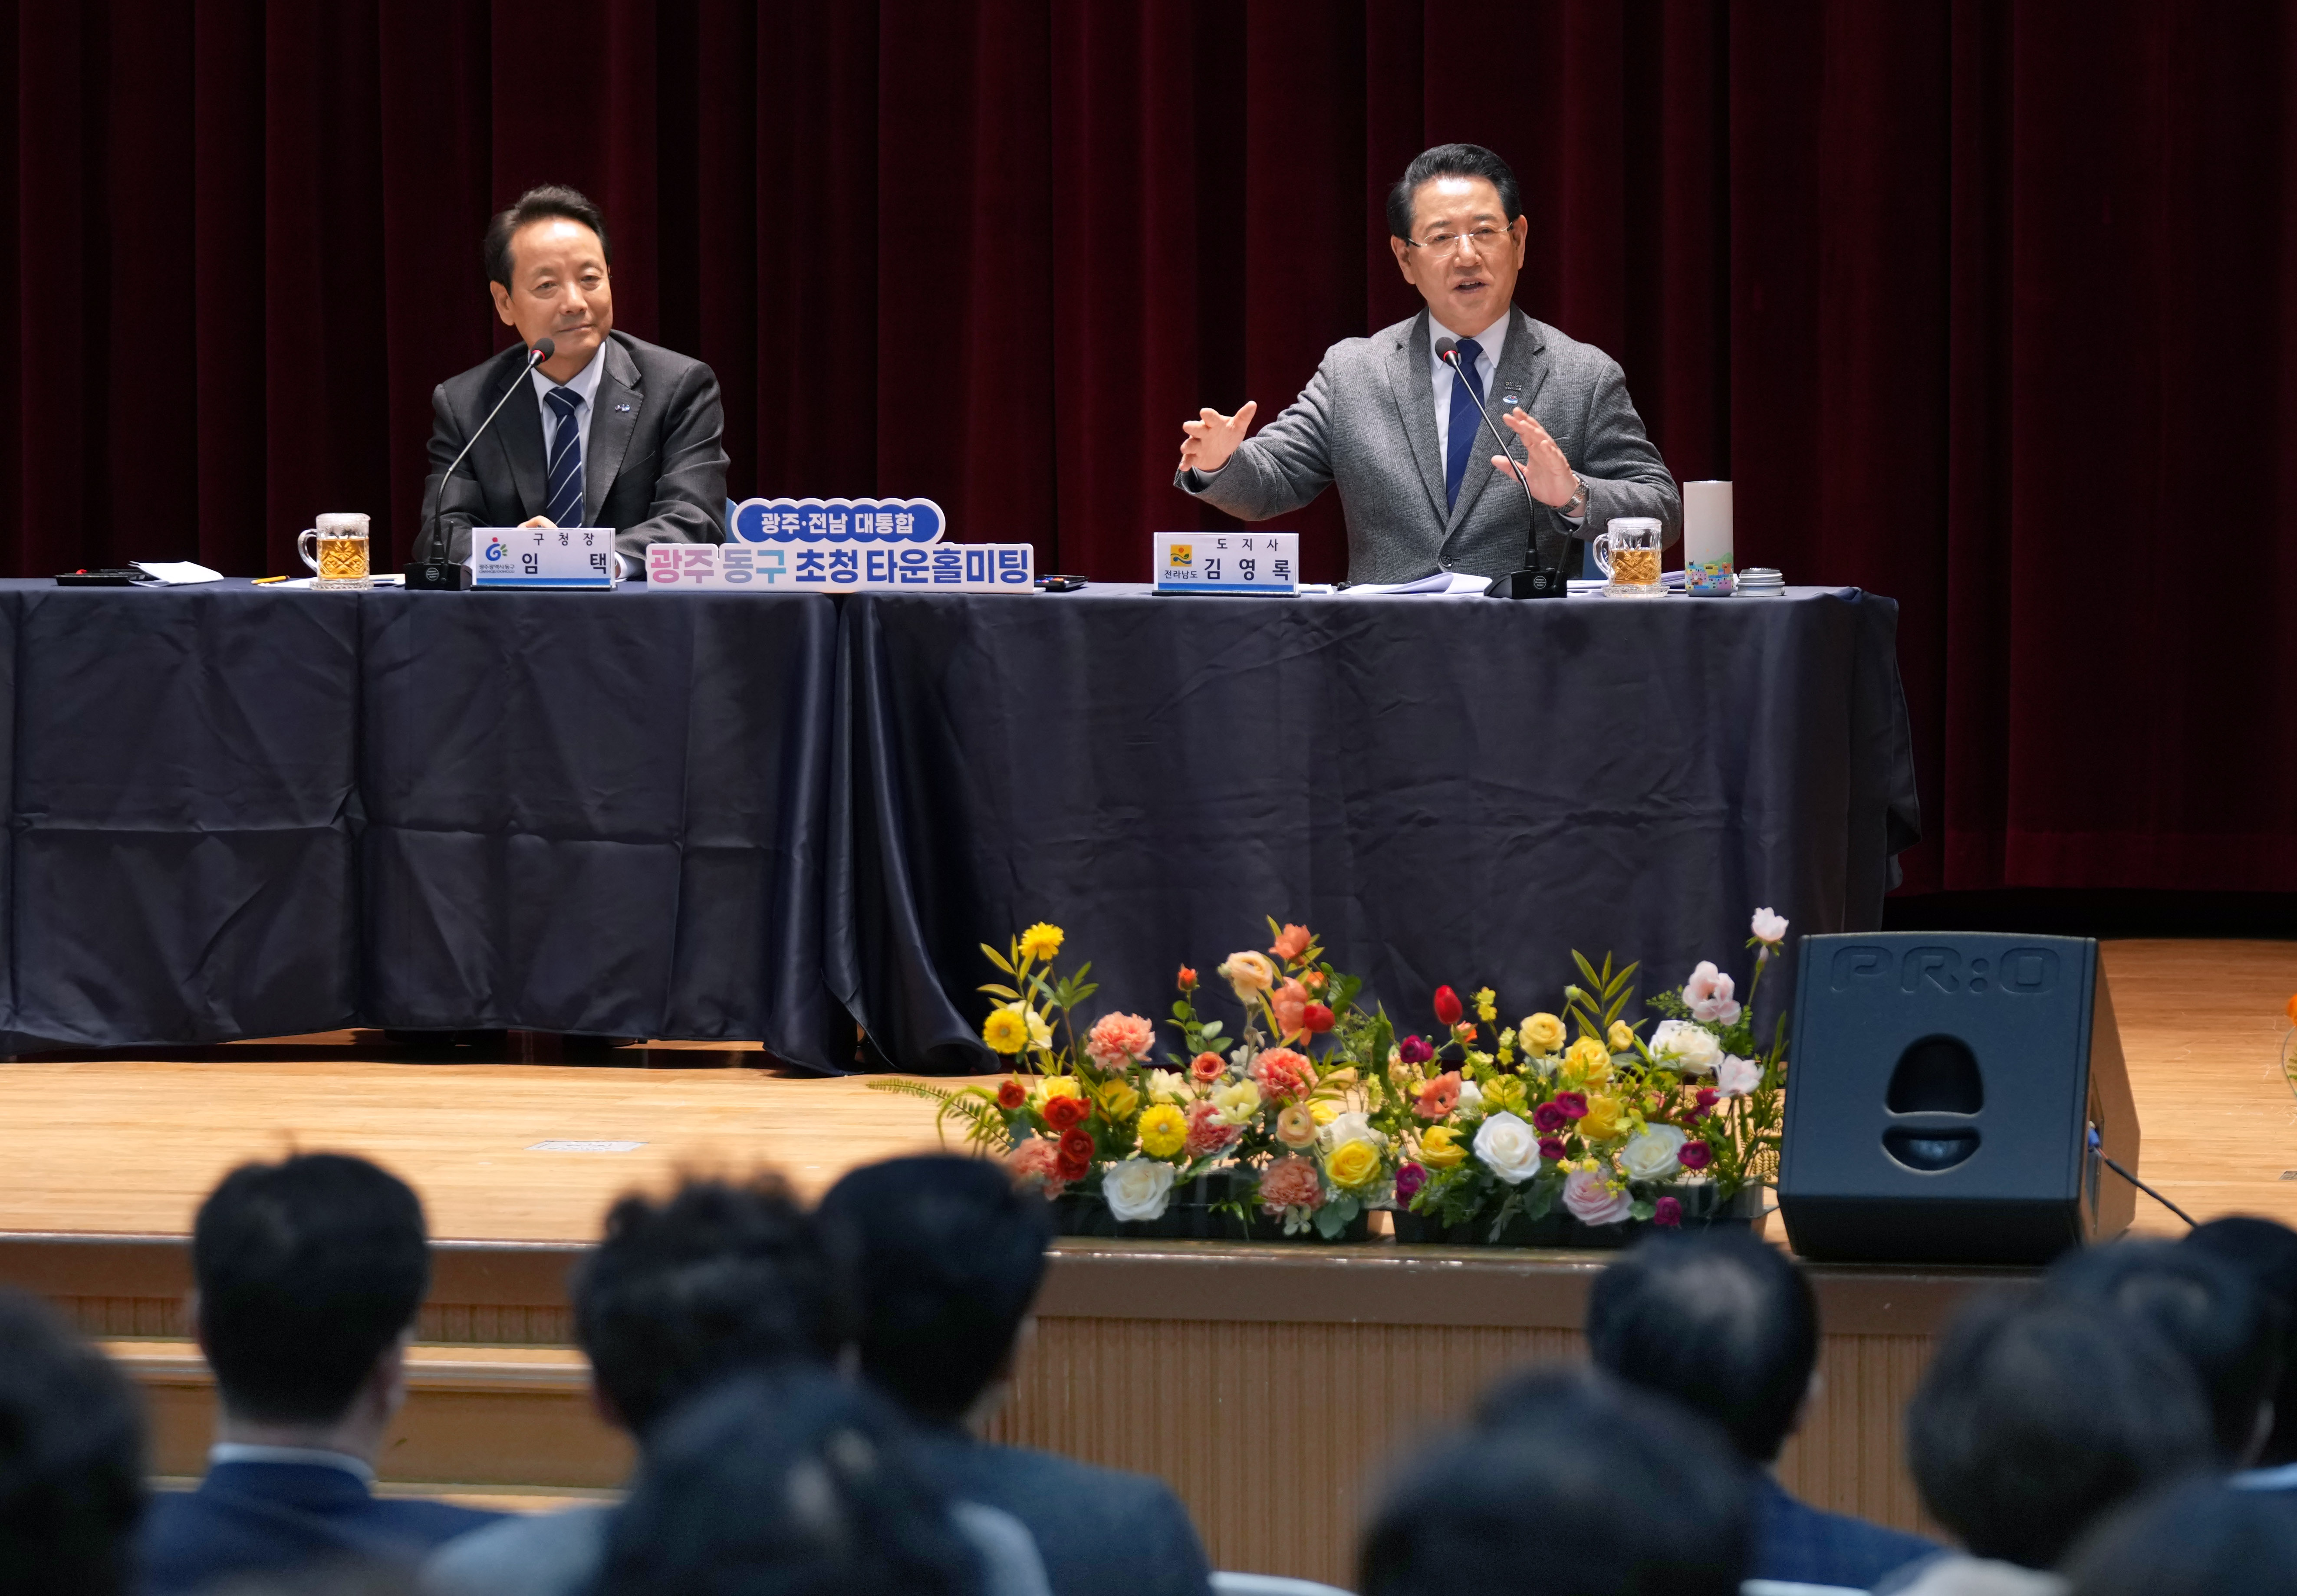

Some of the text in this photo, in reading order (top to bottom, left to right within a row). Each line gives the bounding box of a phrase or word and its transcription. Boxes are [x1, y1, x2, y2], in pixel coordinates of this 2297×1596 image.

[761, 512, 915, 534] 광주·전남 대통합
[651, 548, 1028, 584] 광주 동구 초청 타운홀미팅
[1164, 569, 1198, 579] 전라남도
